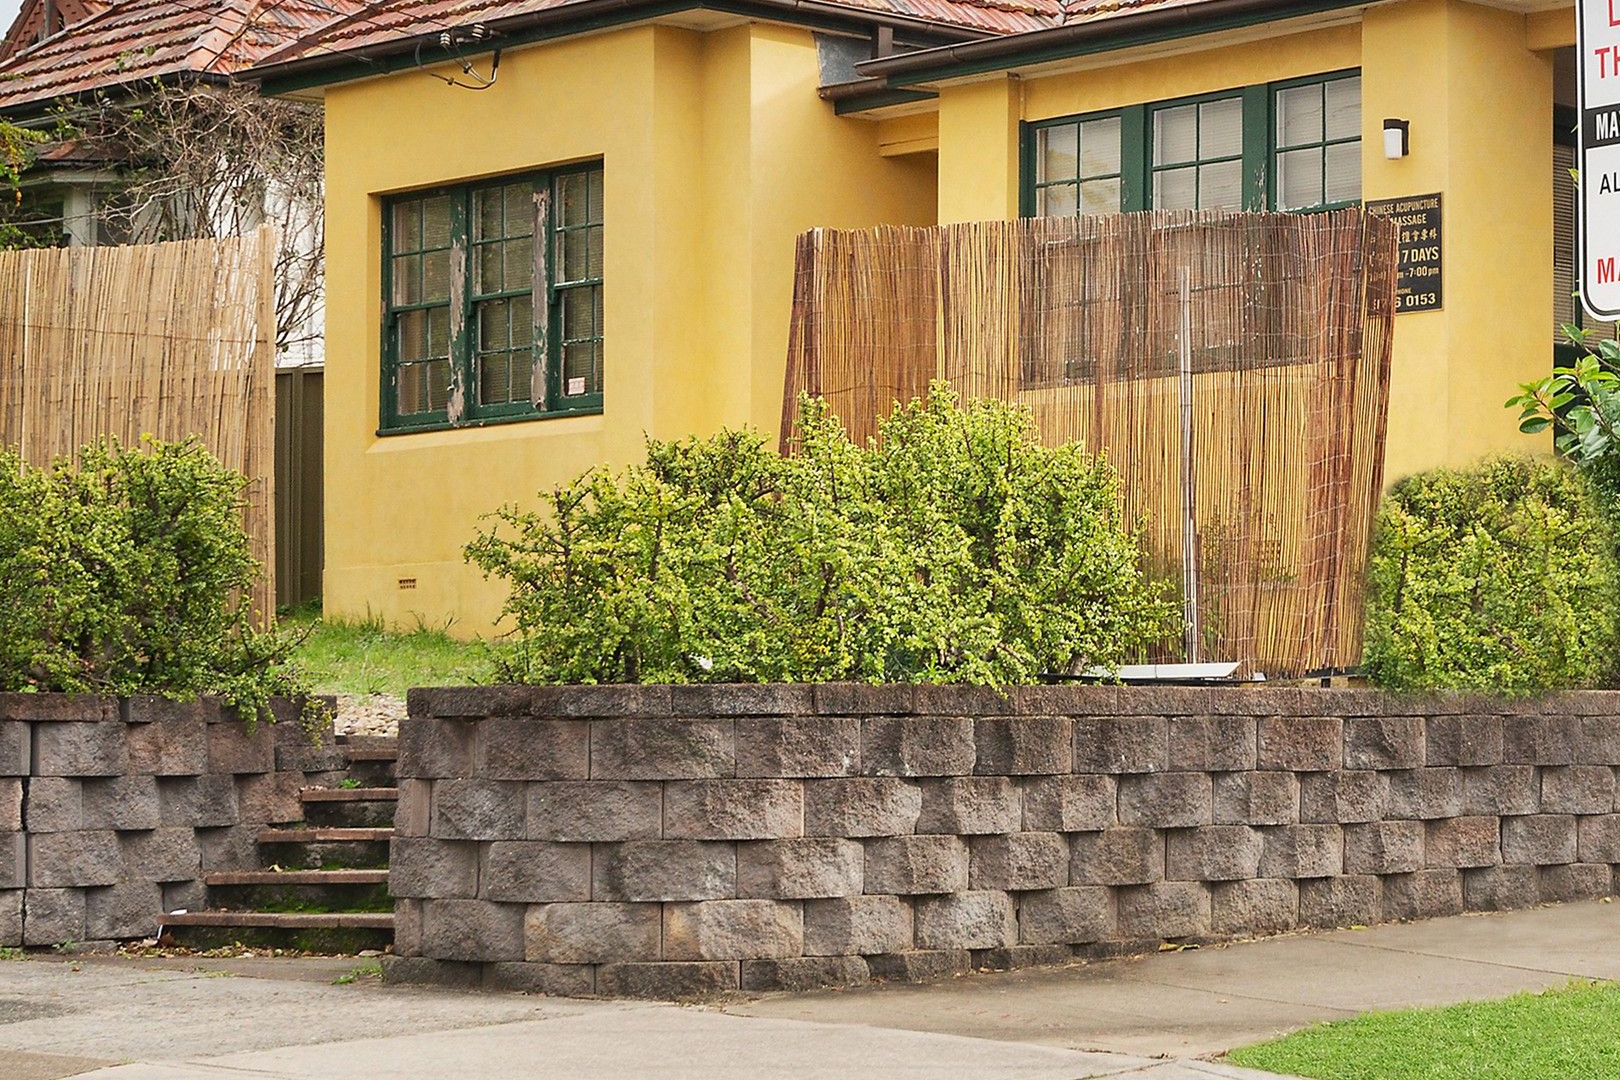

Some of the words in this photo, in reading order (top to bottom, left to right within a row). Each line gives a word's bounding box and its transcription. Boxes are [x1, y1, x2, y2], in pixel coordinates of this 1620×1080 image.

[1395, 198, 1439, 213] ACUPUNCTURE
[1402, 250, 1408, 263] 7
[1411, 246, 1439, 262] DAYS
[1406, 293, 1436, 307] 0153
